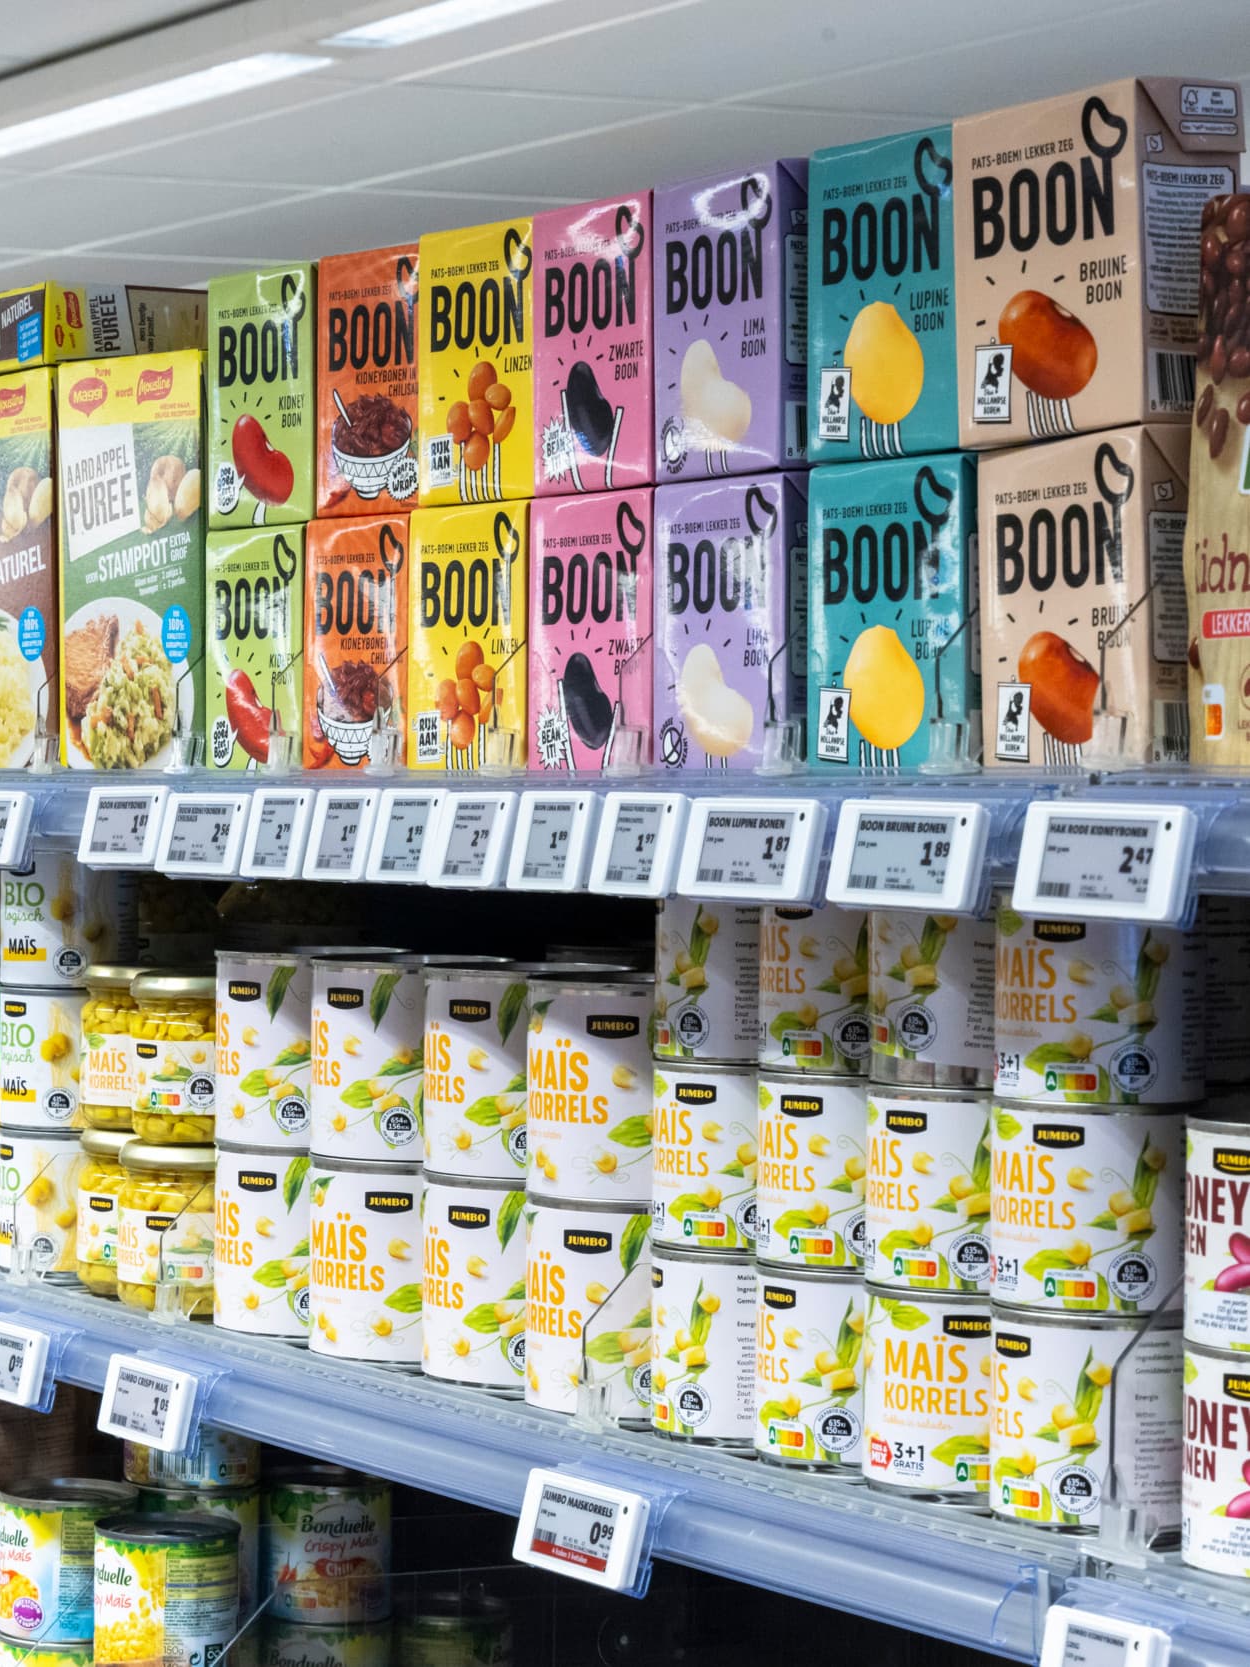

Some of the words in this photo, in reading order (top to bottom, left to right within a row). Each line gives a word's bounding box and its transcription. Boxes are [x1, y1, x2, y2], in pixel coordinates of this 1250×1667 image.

[971, 150, 1022, 170] PATS-BOEM!
[1024, 143, 1056, 161] LEKKER
[1057, 138, 1075, 153] ZEG
[822, 185, 864, 200] PATS-BOEM!
[865, 178, 893, 194] LEKKER
[893, 175, 909, 188] ZEG
[972, 156, 1115, 259] BOON
[822, 195, 940, 286] BOON
[466, 262, 487, 276] LEKKER
[487, 260, 500, 272] ZEG
[665, 225, 763, 314] BOON
[1079, 255, 1128, 282] BRUINE
[544, 256, 637, 338] BOON
[909, 288, 950, 311] LUPINE
[1086, 280, 1123, 304] BOON
[0, 294, 34, 329] NATUREL
[430, 275, 524, 352] BOON
[914, 311, 945, 332] BOON
[100, 293, 121, 353] PUREE
[743, 319, 767, 338] LIMA
[328, 299, 419, 372] BOON
[218, 316, 299, 387] BOON
[608, 340, 645, 362] ZWARTE
[740, 339, 767, 358] BOON
[503, 354, 533, 374] LINZEN
[613, 361, 639, 382] BOON
[355, 368, 408, 385] KIDNEYBONEN
[72, 383, 103, 402] Maggi
[278, 394, 306, 411] KIDNEY
[281, 411, 303, 428] BOON
[430, 439, 451, 457] RIJK
[66, 444, 131, 488] AARDAPPEL
[430, 454, 451, 471] AAN
[68, 472, 134, 535] PUREE
[994, 488, 1041, 506] PATS-BOEM!
[1042, 484, 1072, 501] LEKKER
[1072, 482, 1088, 496] ZEG
[822, 505, 864, 521] PATS-BOEM!
[865, 504, 893, 519] LEKKER
[893, 502, 908, 515] ZEG
[705, 520, 729, 533] LEKKER
[729, 518, 741, 529] ZEG
[169, 530, 191, 548] EXTRA
[455, 542, 476, 555] LEKKER
[476, 541, 489, 553] ZEG
[543, 536, 578, 549] PATS-BOEM!
[578, 534, 600, 546] LEKKER
[600, 533, 613, 545] ZEG
[995, 501, 1123, 596] BOON
[97, 537, 168, 583] STAMPPOT
[822, 521, 940, 605] BOON
[667, 535, 767, 615] BOON
[421, 556, 511, 628] BOON
[542, 550, 637, 626] BOON
[215, 575, 288, 641] BOON
[316, 568, 396, 636] BOON
[746, 628, 769, 647] LIMA
[743, 648, 770, 668] BOON
[418, 718, 438, 731] RIJK
[418, 731, 438, 746] AAN
[541, 728, 562, 744] BEAN
[708, 816, 731, 828] BOON
[730, 817, 756, 829] LUPINE
[756, 818, 786, 830] BONEN
[859, 819, 884, 832] BOON
[885, 820, 917, 833] BRUINE
[917, 821, 947, 834] BONEN
[1049, 823, 1068, 834] HAK
[1068, 824, 1090, 836] RODE
[1090, 825, 1149, 838] KIDNEYBONEN
[4, 881, 46, 907] BIO
[1037, 923, 1082, 936] JUMBO
[7, 937, 38, 956] MAÏS
[229, 985, 258, 997] JUMBO
[329, 992, 361, 1004] JUMBO
[452, 1004, 488, 1016] JUMBO
[590, 1020, 636, 1032] JUMBO
[88, 1047, 128, 1074] MAÏS
[528, 1038, 590, 1092] MAÏS
[2, 1075, 28, 1097] MAÏS
[677, 1086, 714, 1100] JUMBO
[782, 1099, 821, 1113] JUMBO
[887, 1114, 924, 1129] JUMBO
[1036, 1129, 1081, 1142] JUMBO
[240, 1175, 274, 1187] JUMBO
[994, 1145, 1056, 1196] MAÏS
[368, 1196, 410, 1208] JUMBO
[450, 1211, 487, 1223] JUMBO
[311, 1211, 368, 1262] MAÏS
[567, 1235, 609, 1248] JUMBO
[311, 1257, 386, 1292] KORRELS
[997, 1257, 1021, 1277] 3+1
[997, 1336, 1029, 1355] JUMBO
[883, 1334, 970, 1385] MAÏS
[119, 1369, 139, 1384] JUMBO
[137, 1374, 155, 1390] CRISPY
[154, 1380, 169, 1394] MAIS
[883, 1381, 990, 1419] KORRELS
[893, 1441, 926, 1462] 3+1
[892, 1459, 926, 1472] GRATIS
[542, 1489, 568, 1505] JUMBO
[566, 1496, 614, 1519] MAISKORRELS
[300, 1514, 377, 1538] Bonduelle
[303, 1536, 348, 1559] Crispy
[349, 1534, 380, 1550] Maïs
